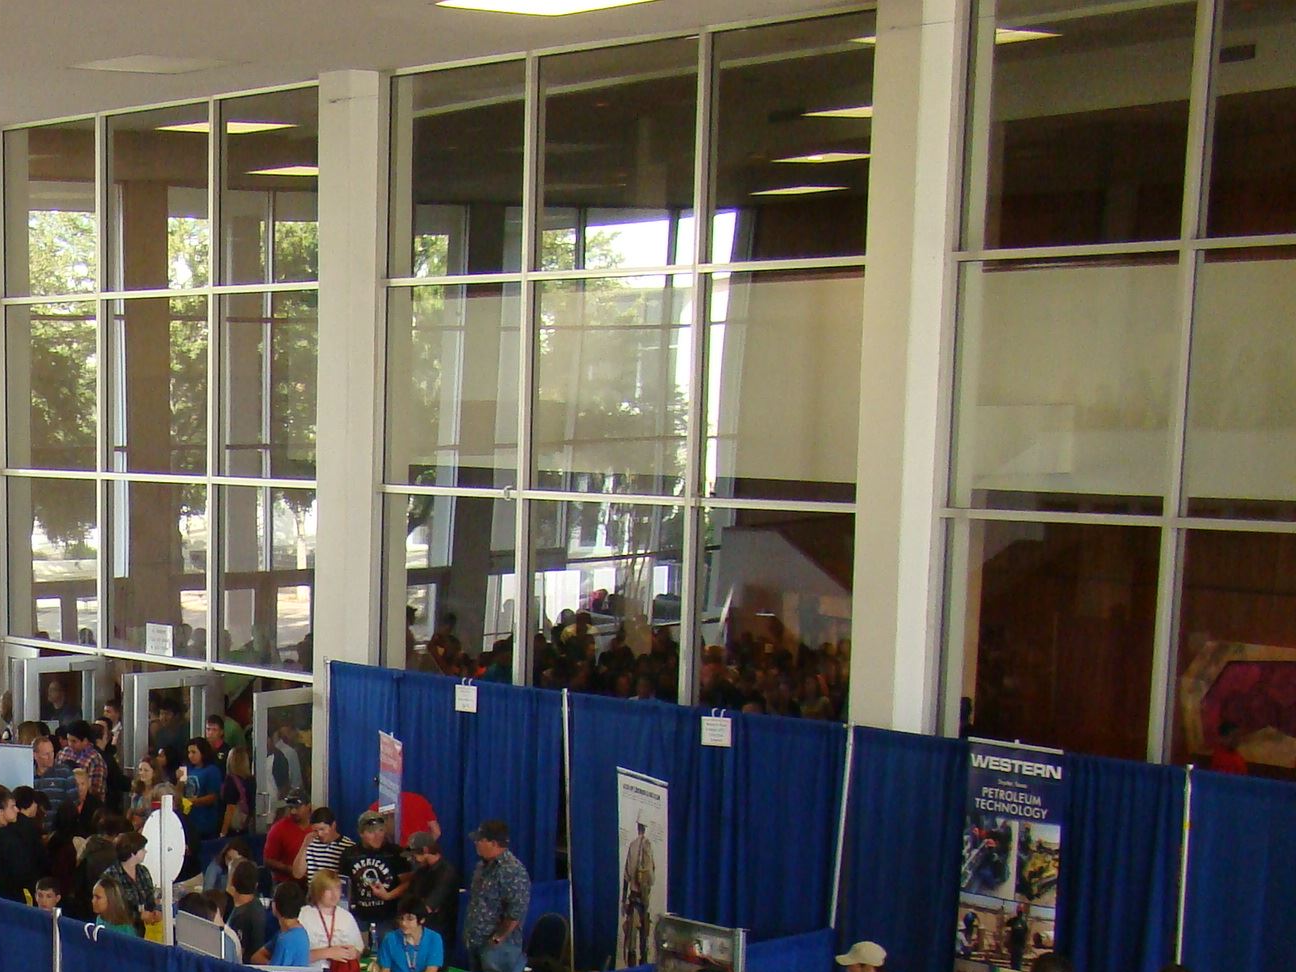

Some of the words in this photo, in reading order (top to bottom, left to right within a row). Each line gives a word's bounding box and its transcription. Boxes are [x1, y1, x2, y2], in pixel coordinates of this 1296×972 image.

[971, 753, 1062, 780] WESTERN
[982, 787, 1041, 806] PETROLEUM
[975, 798, 1048, 819] TECHNOLOGY
